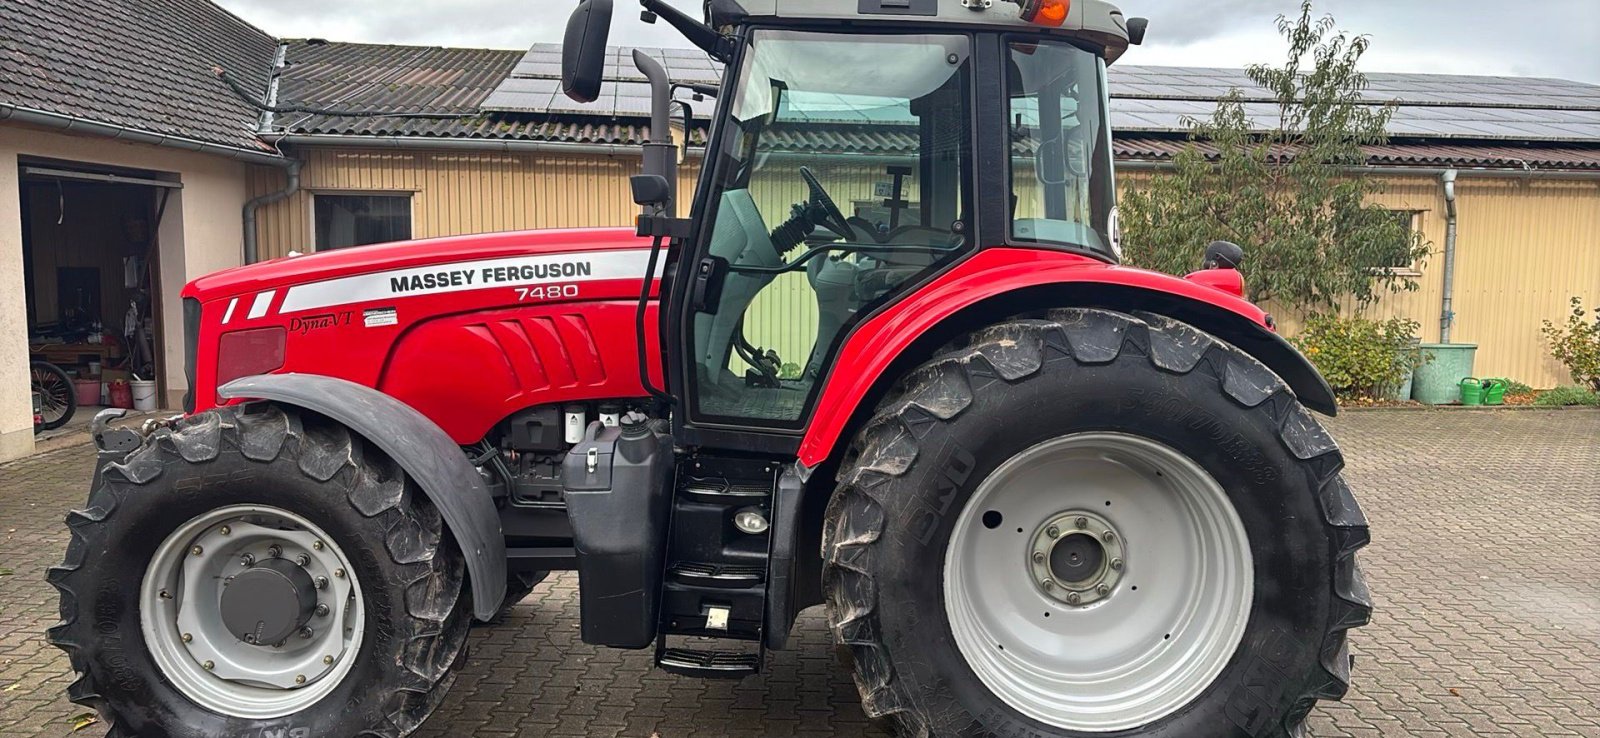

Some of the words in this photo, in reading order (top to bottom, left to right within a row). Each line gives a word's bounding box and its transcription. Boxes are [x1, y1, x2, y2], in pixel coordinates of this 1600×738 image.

[390, 269, 475, 293] MASSEY
[482, 261, 591, 283] FERGUSON
[514, 284, 579, 301] 7480
[289, 311, 355, 335] Dyna-VT
[898, 435, 977, 547] BKT
